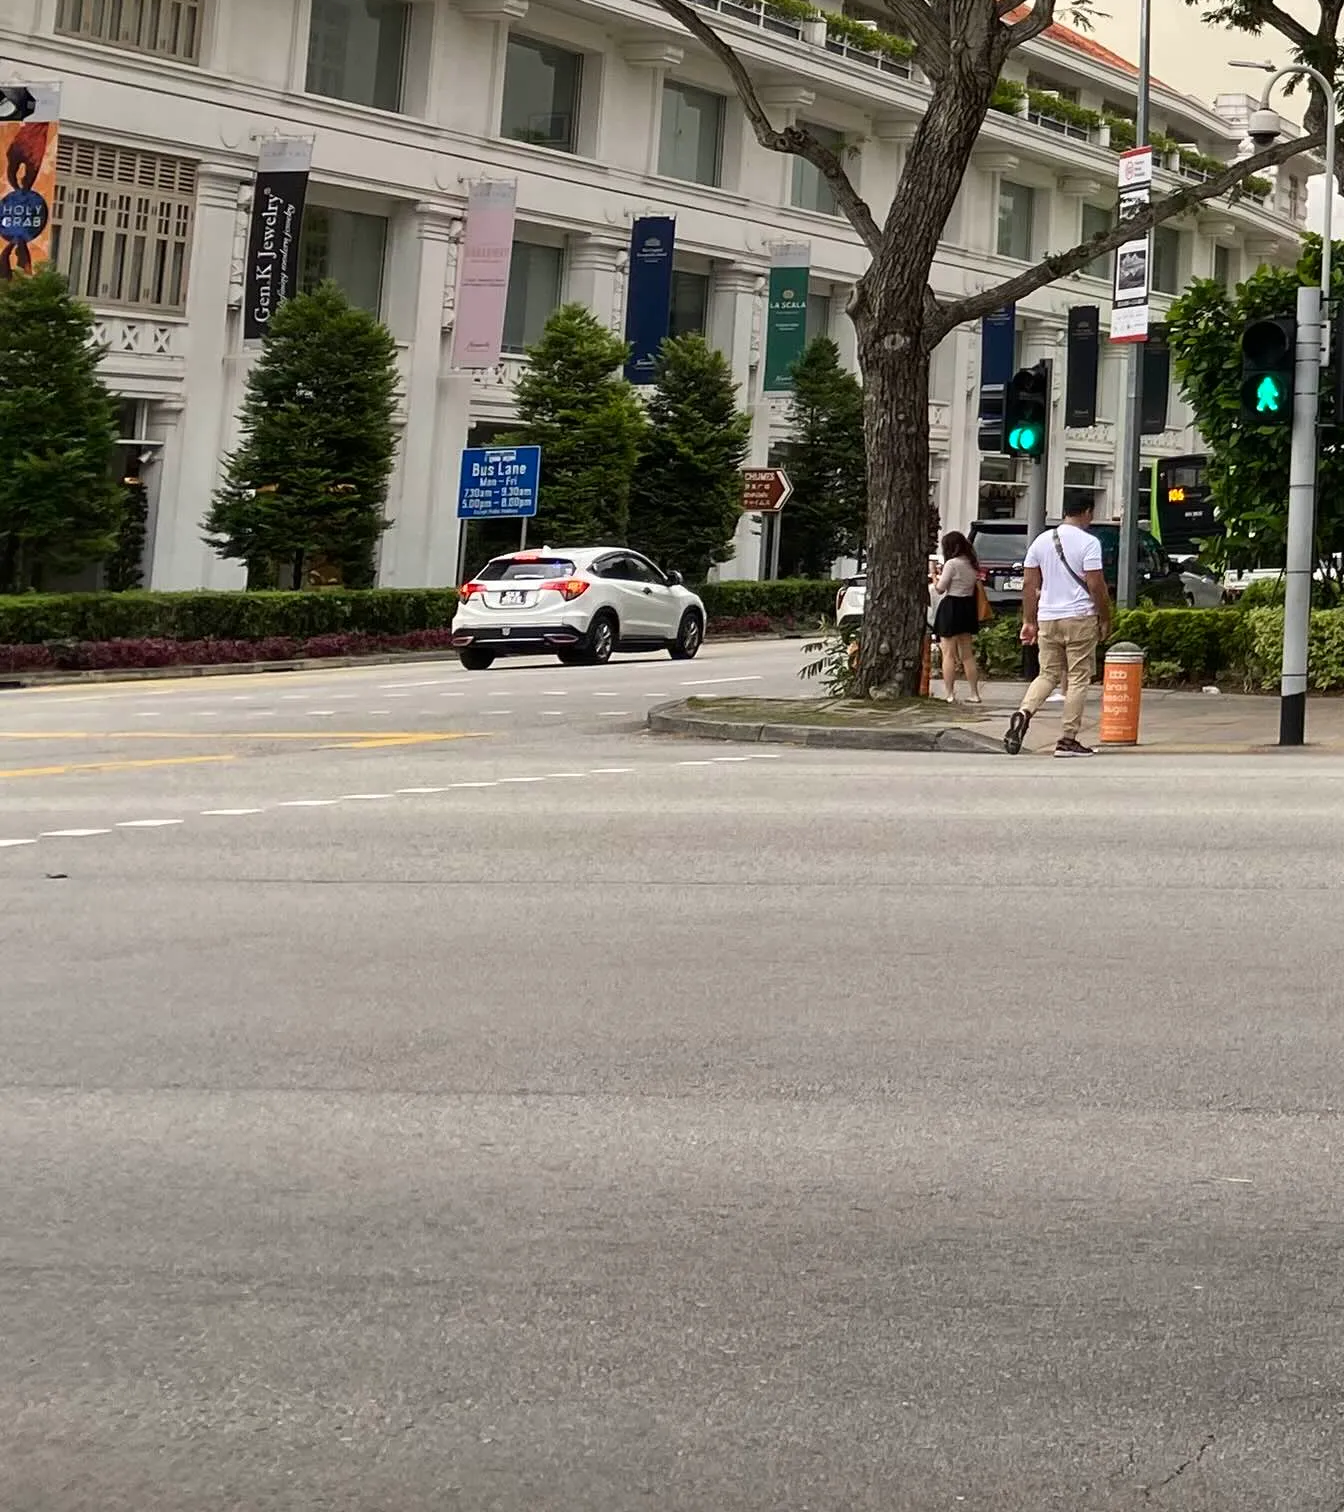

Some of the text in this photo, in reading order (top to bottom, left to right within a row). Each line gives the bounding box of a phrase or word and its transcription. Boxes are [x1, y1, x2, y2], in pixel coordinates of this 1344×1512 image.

[3, 204, 42, 216] HOLY
[1, 216, 41, 228] CRAB
[472, 462, 527, 477] Bus Lane
[480, 477, 497, 487] Mon
[506, 476, 518, 486] Fri
